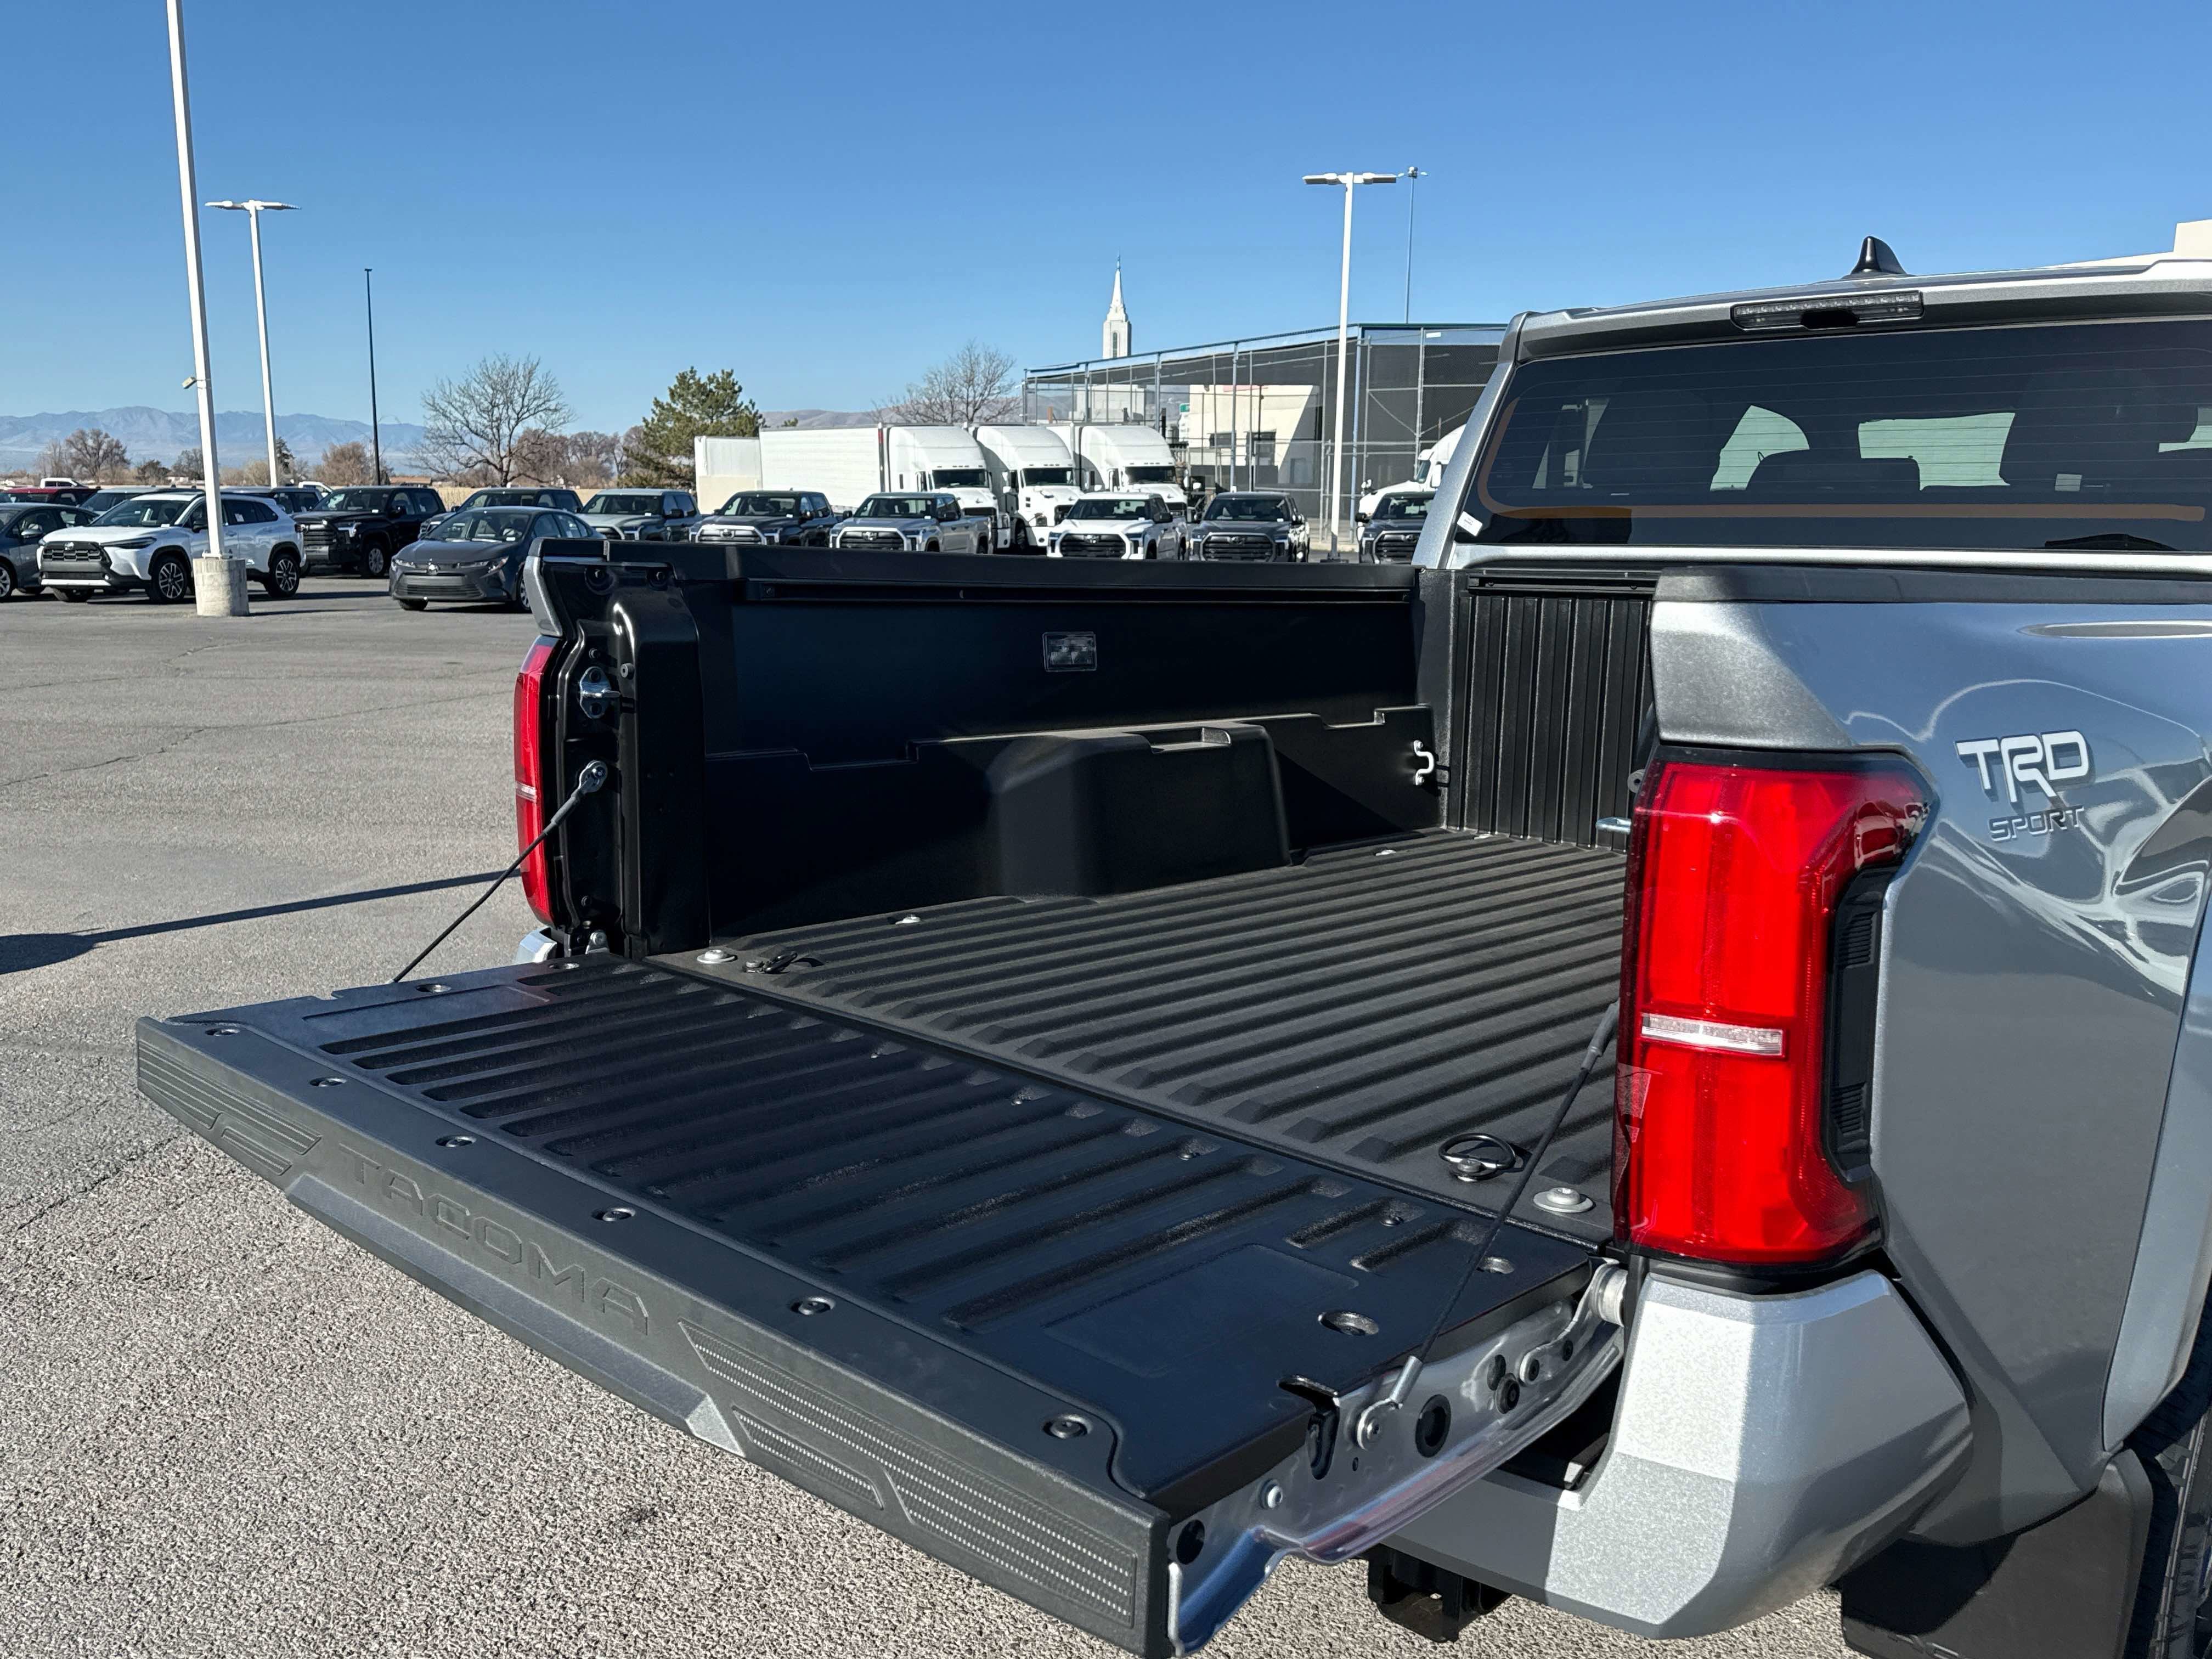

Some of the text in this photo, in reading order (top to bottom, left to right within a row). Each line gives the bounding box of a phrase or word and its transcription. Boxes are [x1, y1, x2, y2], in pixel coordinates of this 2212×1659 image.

[1955, 730, 2091, 803] TRD
[1989, 806, 2084, 842] SPORT
[339, 1143, 648, 1335] TACOMA
